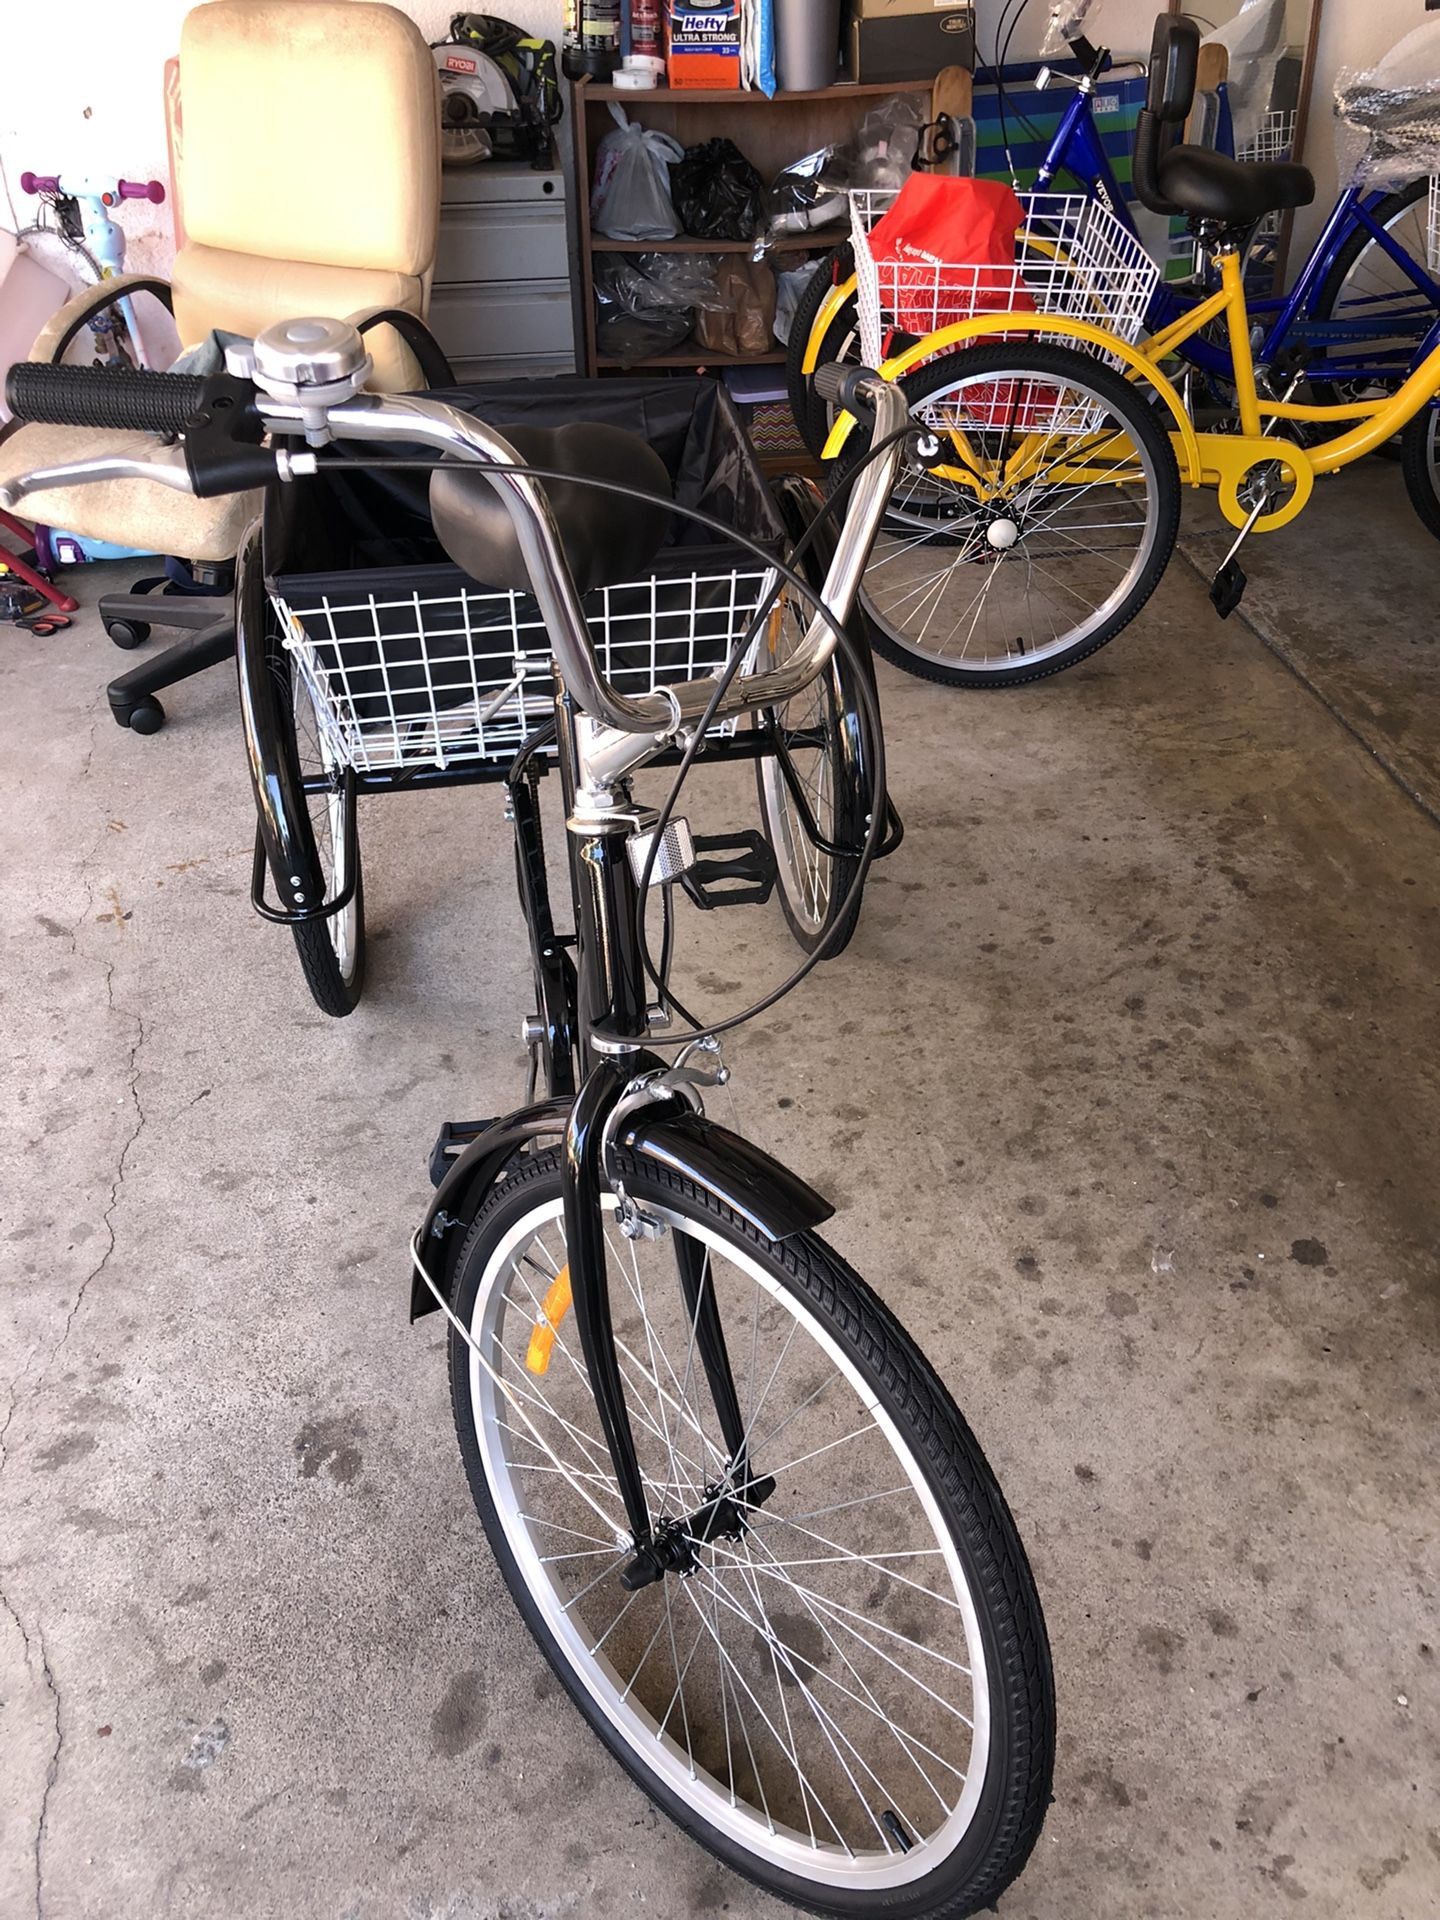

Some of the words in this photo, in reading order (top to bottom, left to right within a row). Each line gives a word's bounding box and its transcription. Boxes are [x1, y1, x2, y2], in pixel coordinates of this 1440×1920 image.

[684, 17, 724, 32] Hefty
[673, 33, 700, 42] ULTRA
[702, 33, 737, 42] STRONG
[447, 57, 476, 71] RYOBI
[1095, 180, 1115, 213] VEVOR
